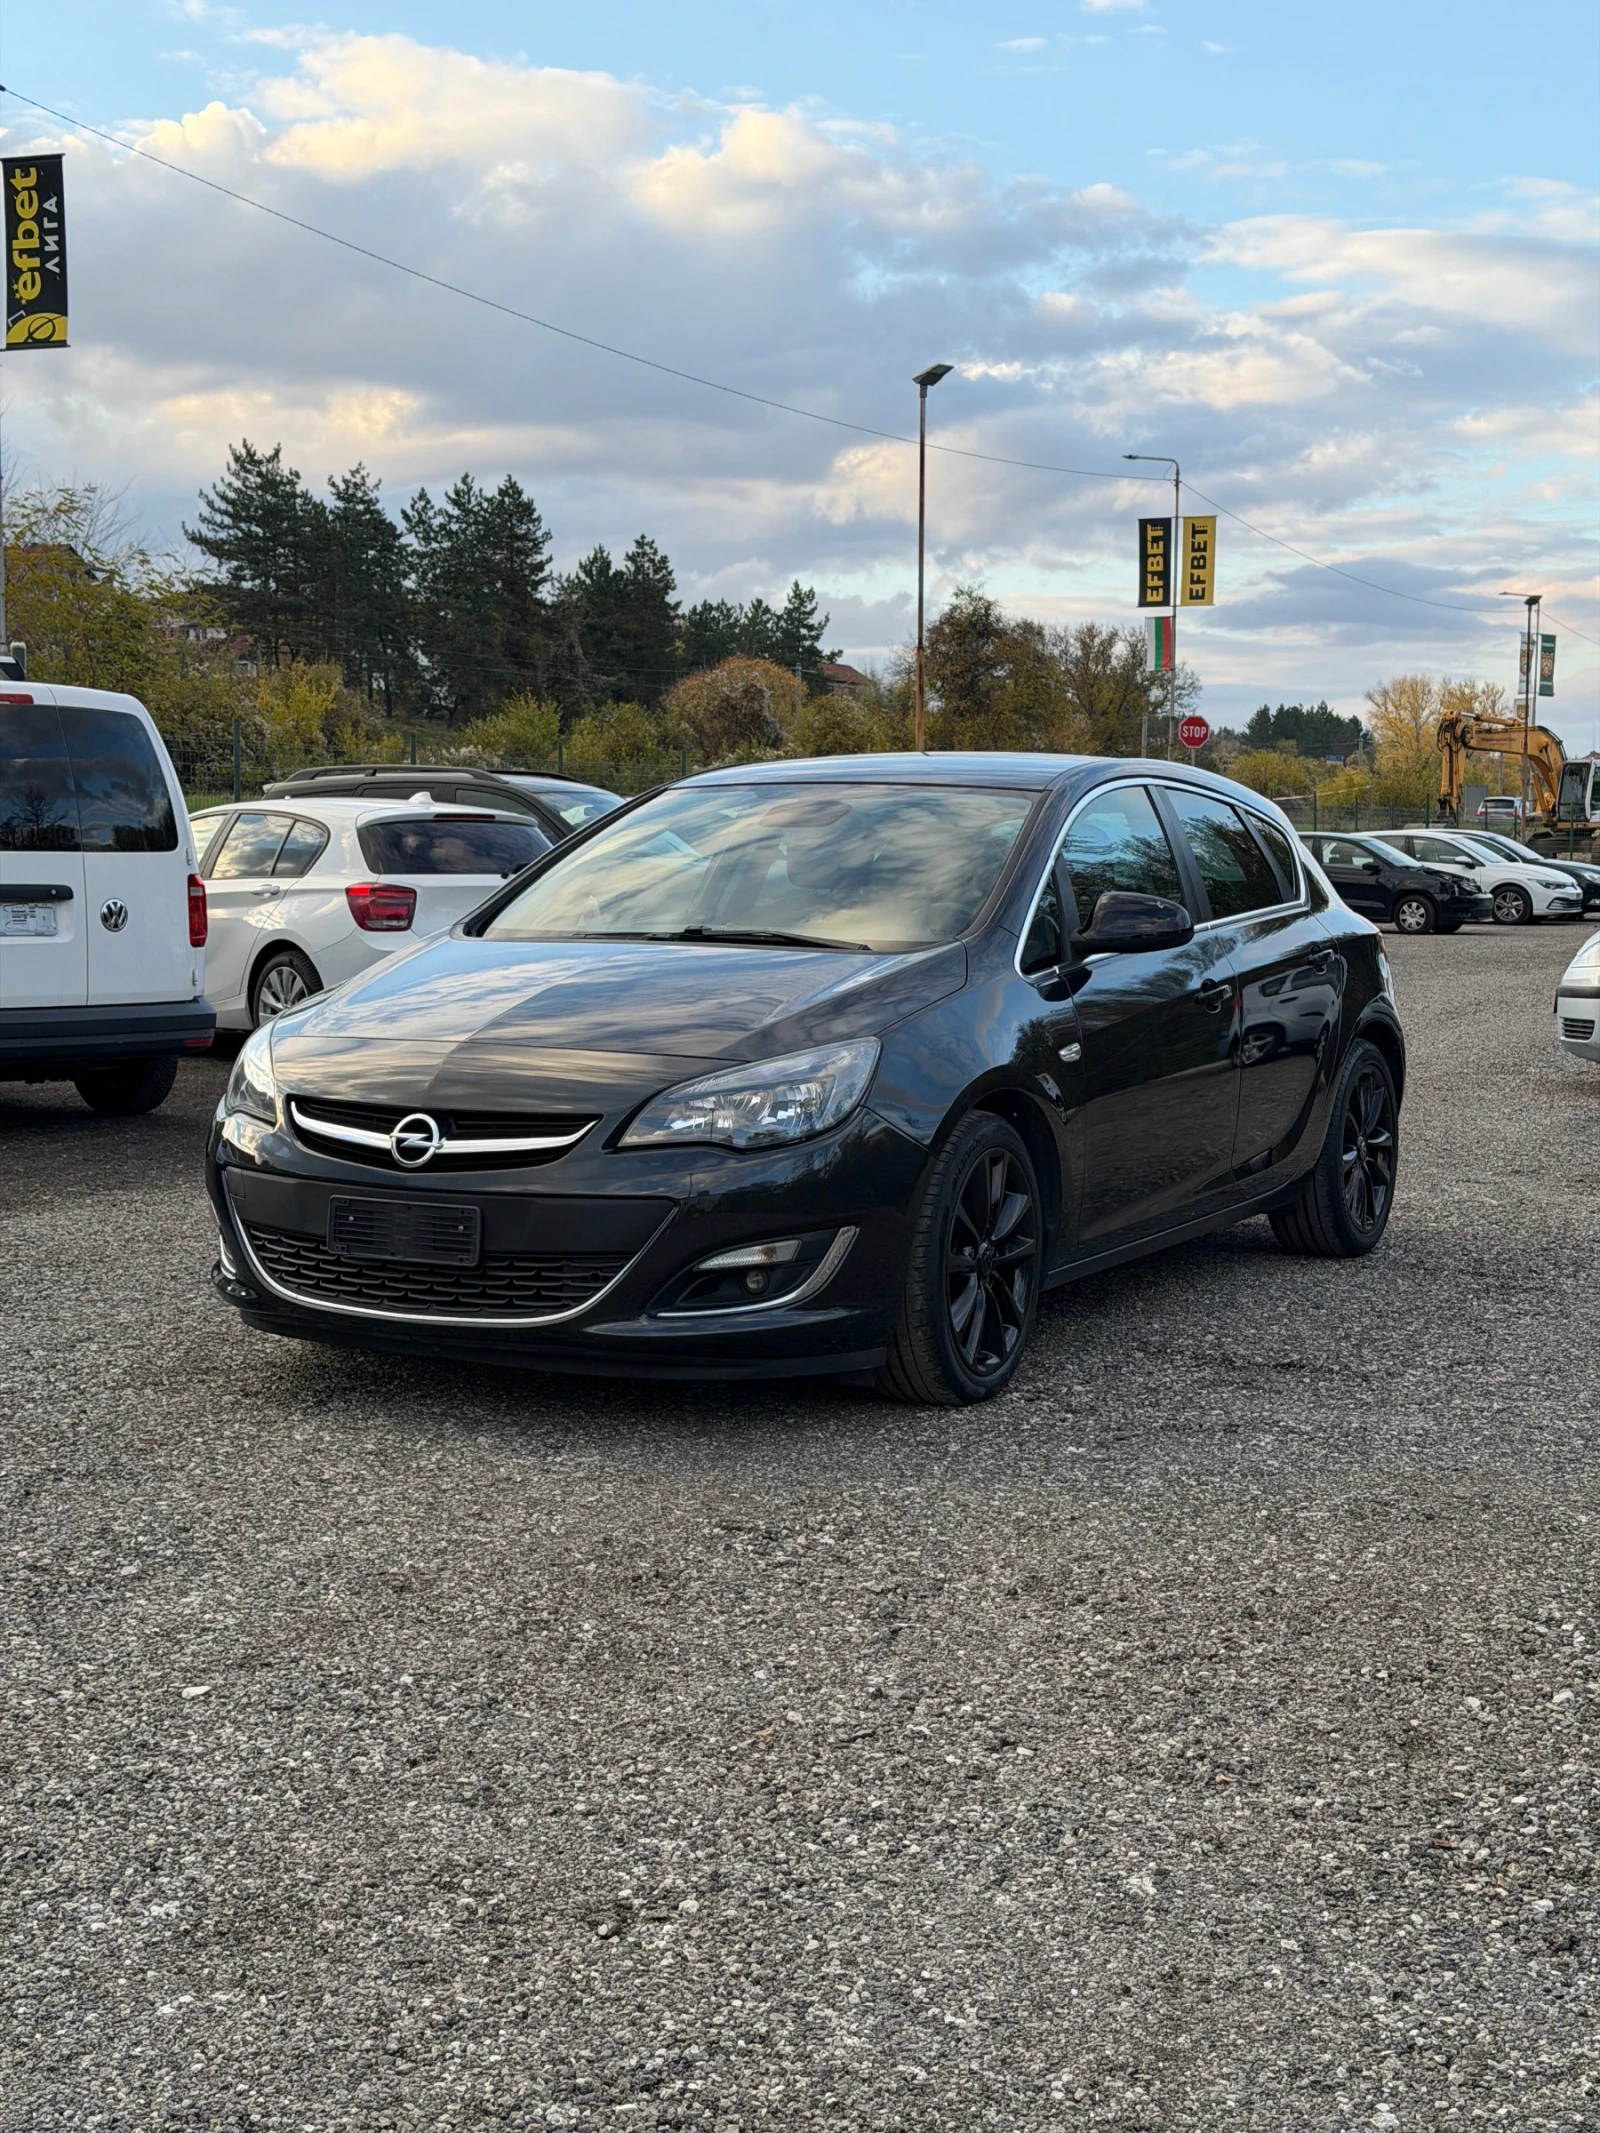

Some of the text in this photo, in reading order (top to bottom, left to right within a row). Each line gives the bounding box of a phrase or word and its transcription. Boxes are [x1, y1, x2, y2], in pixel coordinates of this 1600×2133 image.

[10, 167, 41, 300] efbet
[42, 196, 60, 273] ЛИГА
[1146, 524, 1164, 602] EFBET
[1189, 522, 1208, 600] EFBET
[1182, 725, 1207, 738] STOP
